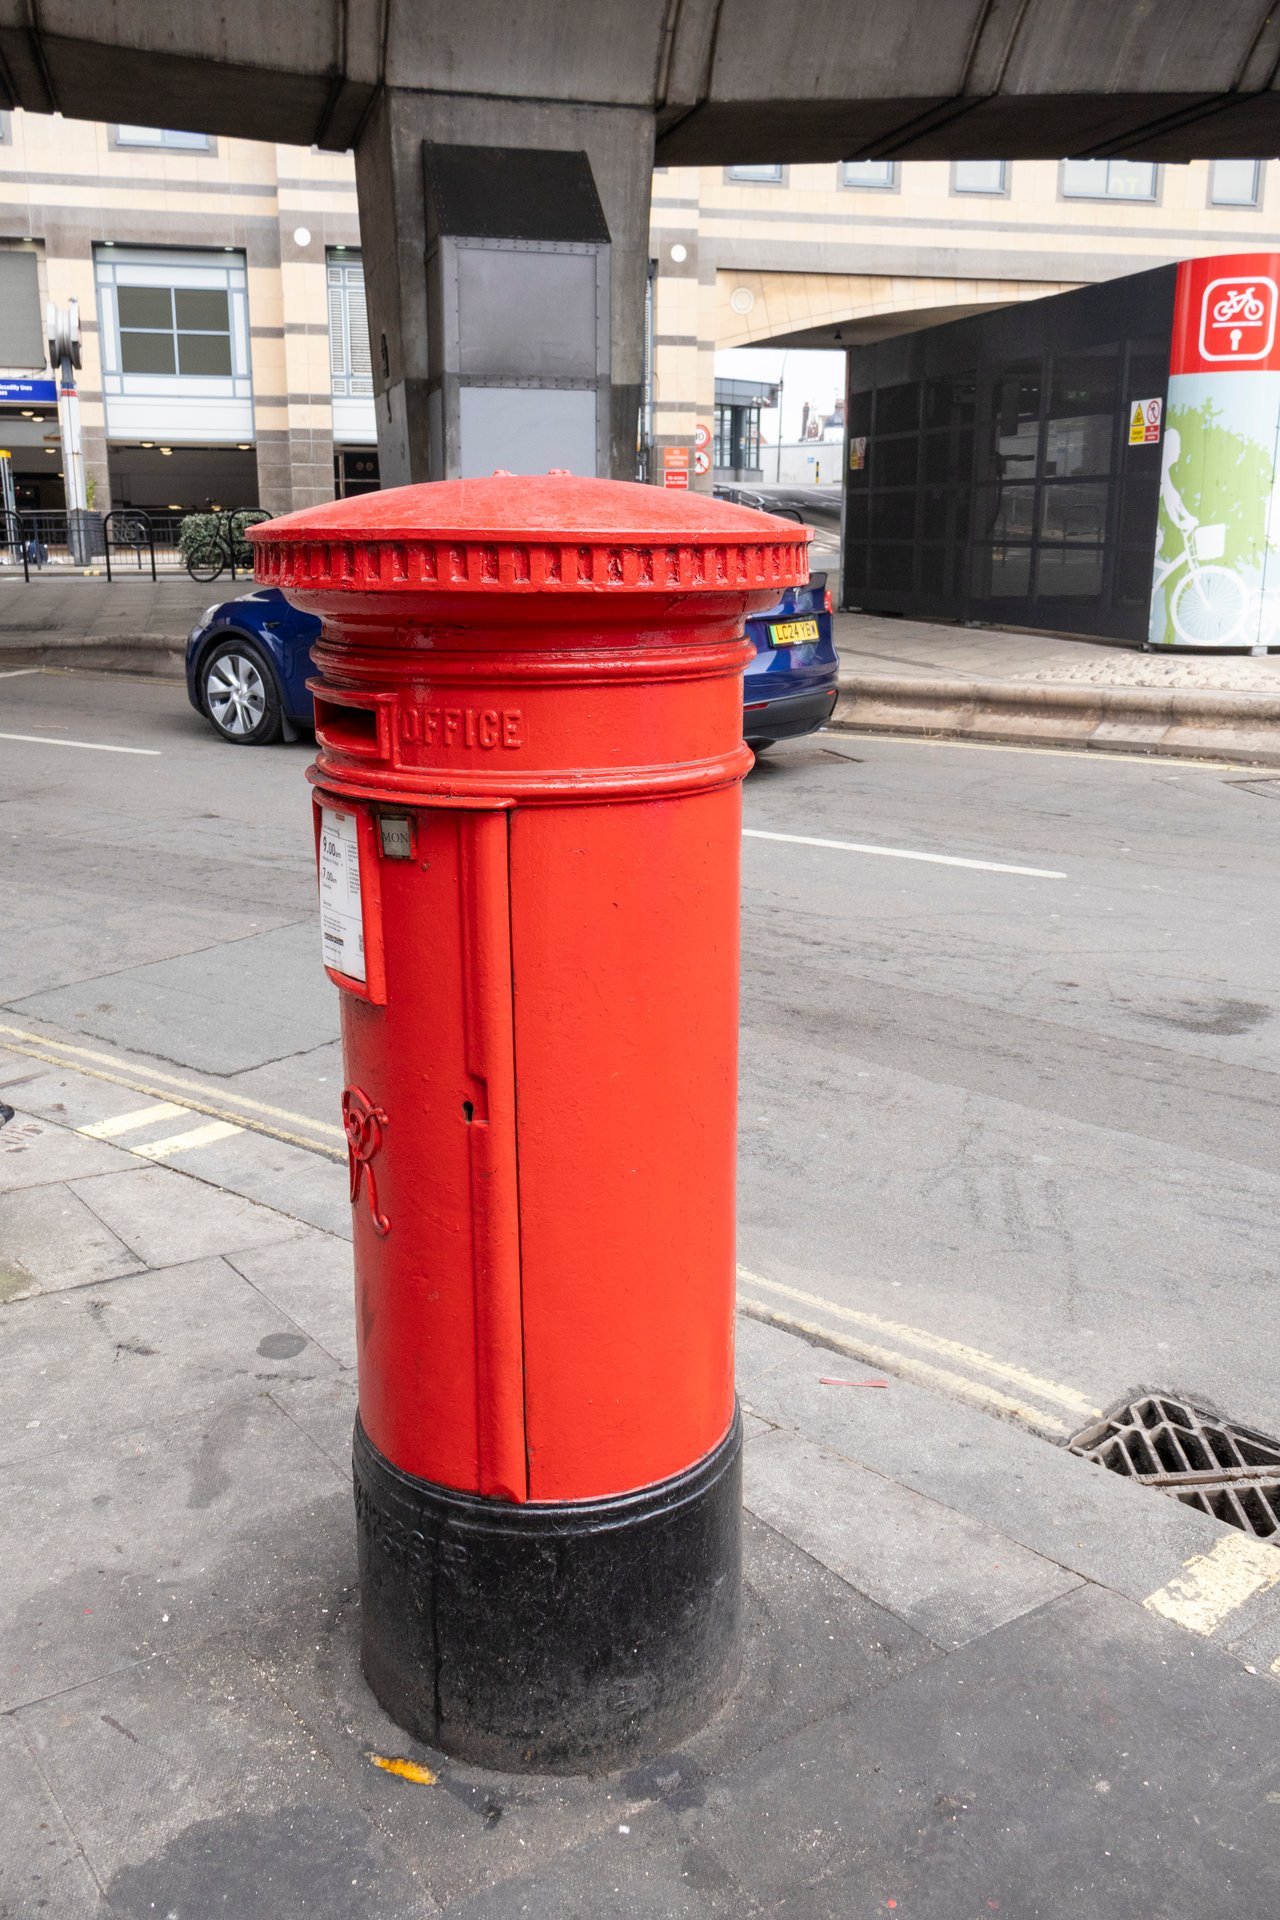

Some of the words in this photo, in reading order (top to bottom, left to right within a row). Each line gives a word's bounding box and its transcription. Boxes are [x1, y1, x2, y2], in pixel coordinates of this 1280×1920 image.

[775, 624, 799, 640] LC24
[401, 706, 522, 749] OFFICE
[382, 832, 408, 843] MON
